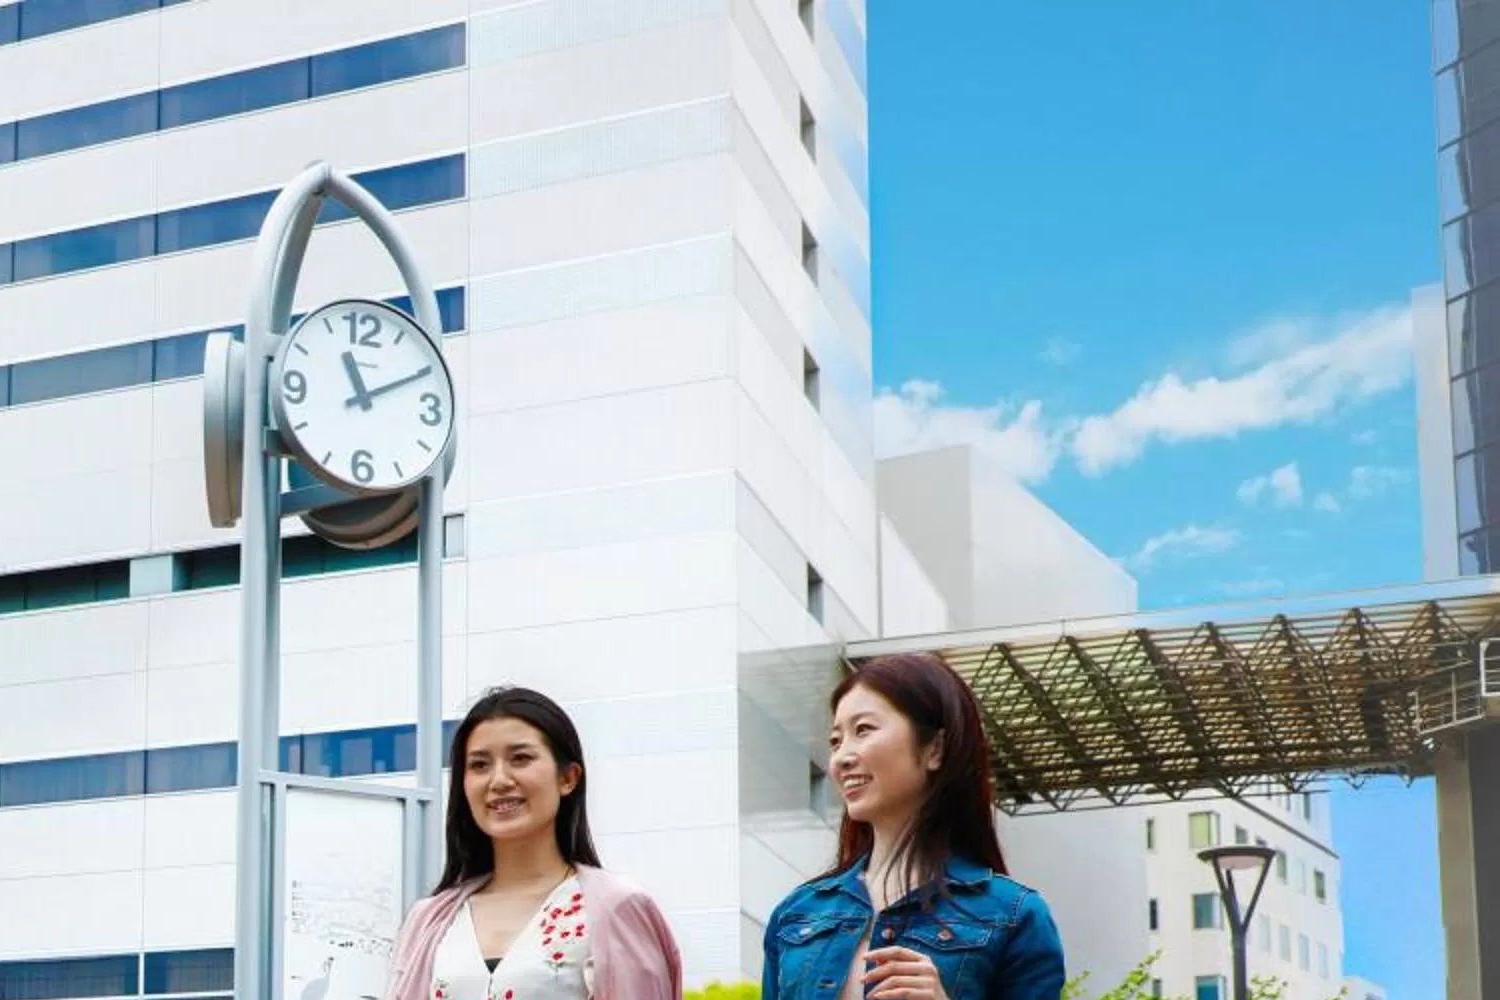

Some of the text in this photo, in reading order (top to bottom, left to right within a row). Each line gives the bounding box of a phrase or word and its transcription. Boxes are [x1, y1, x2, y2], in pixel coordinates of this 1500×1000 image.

[342, 311, 383, 348] 12
[284, 369, 307, 405] 9
[419, 393, 442, 428] 3
[350, 448, 375, 483] 6
